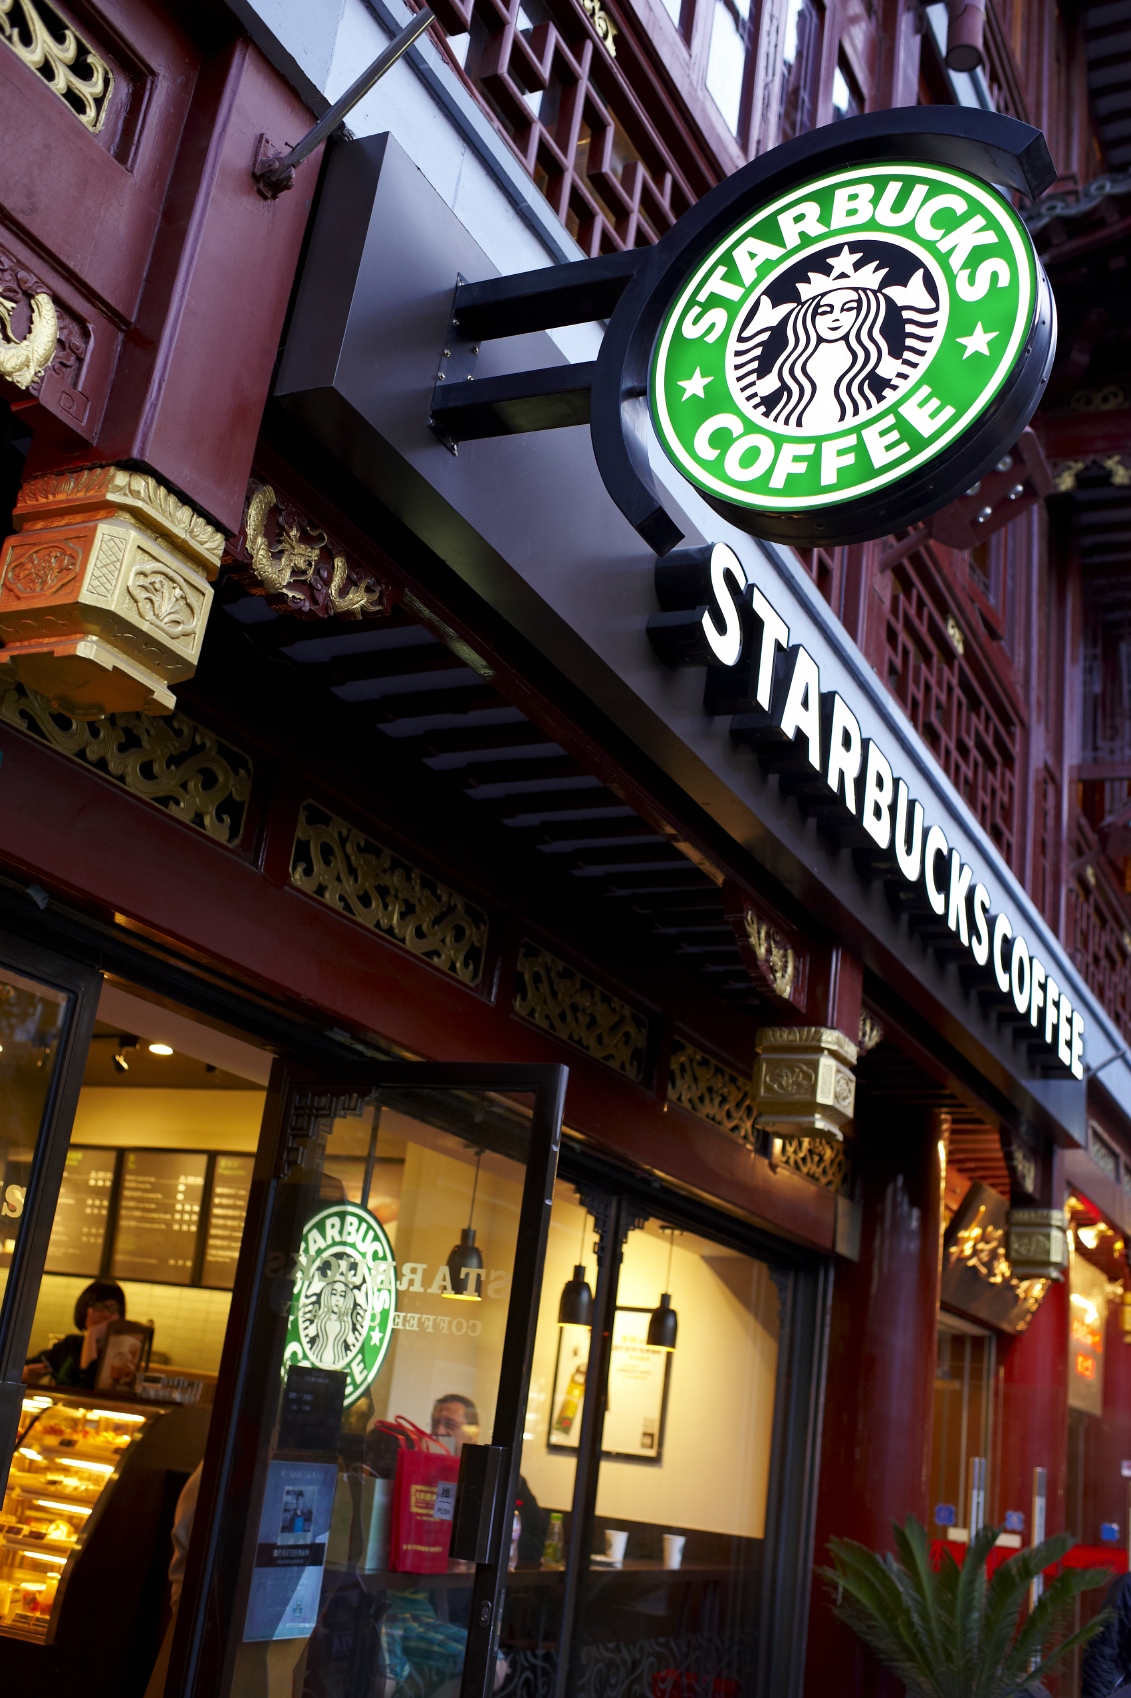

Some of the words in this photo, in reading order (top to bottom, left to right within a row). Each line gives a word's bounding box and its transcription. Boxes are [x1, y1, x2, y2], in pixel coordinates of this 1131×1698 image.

[681, 180, 1011, 344] STARBUCKS
[693, 384, 957, 489] COFFEE
[437, 1507, 451, 1516] PUSH
[441, 1487, 452, 1498] 推
